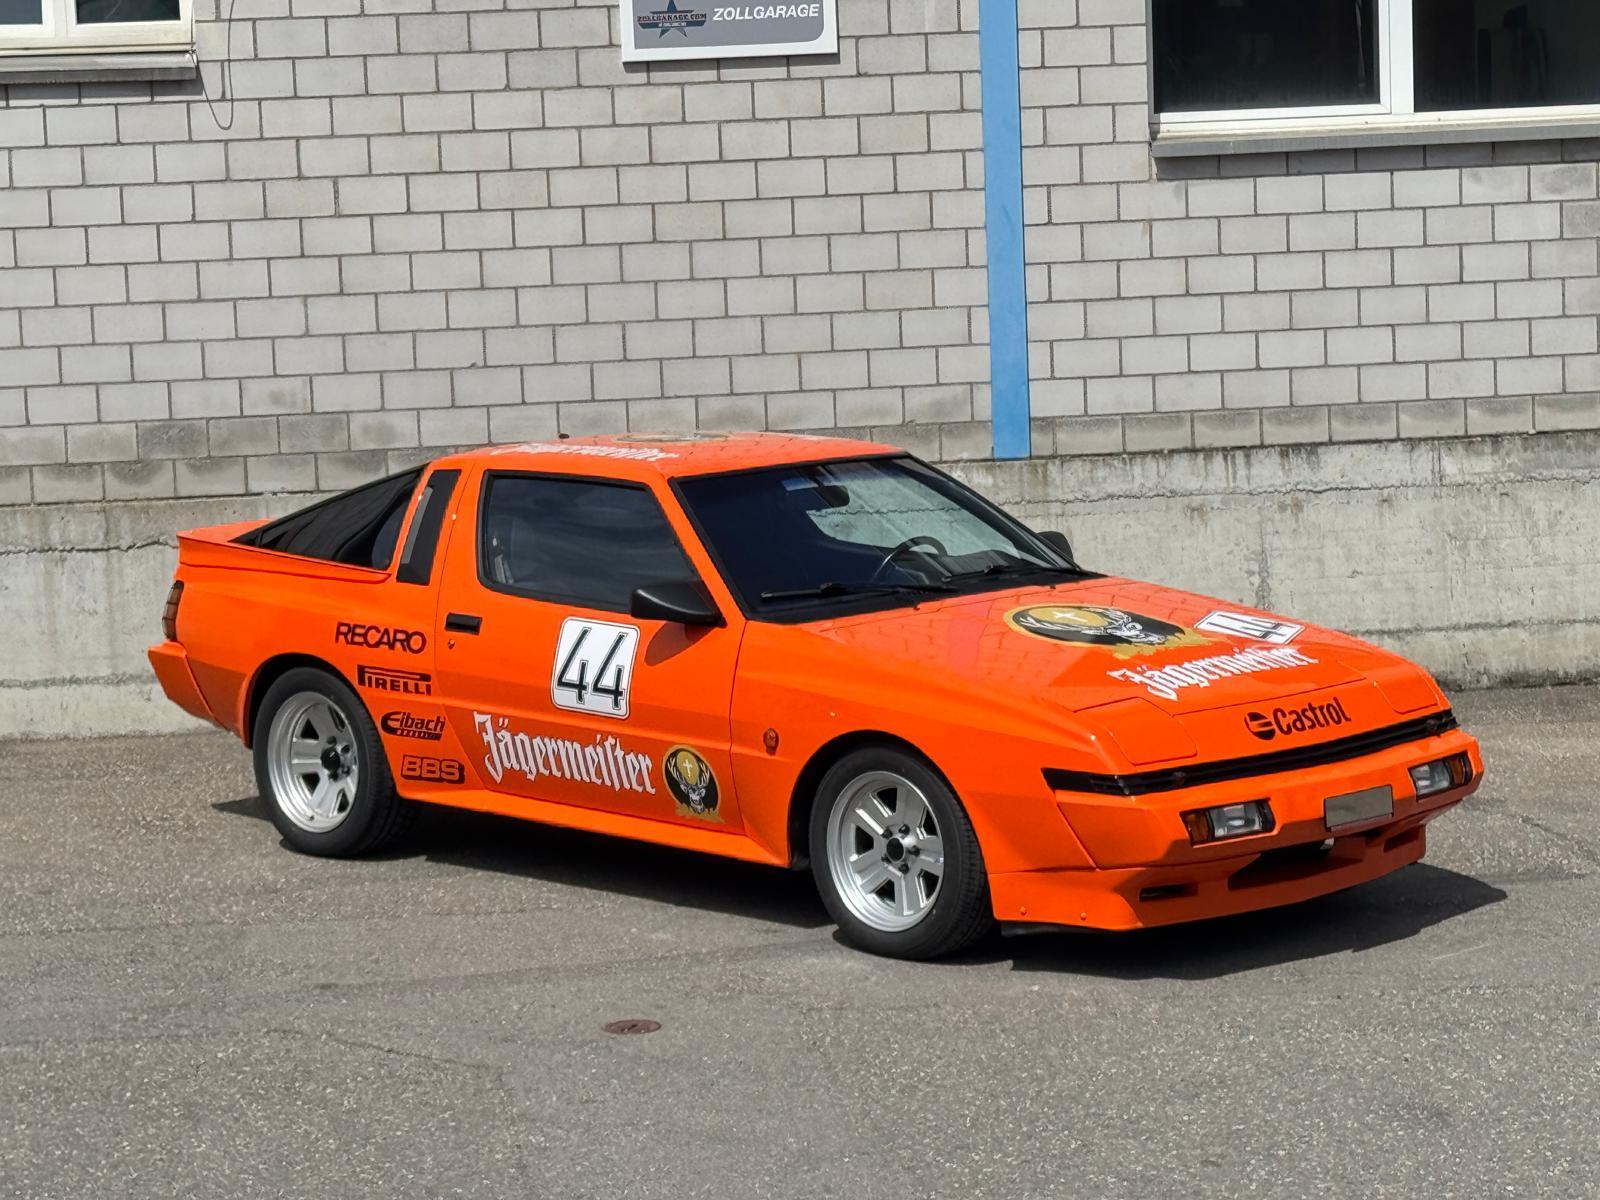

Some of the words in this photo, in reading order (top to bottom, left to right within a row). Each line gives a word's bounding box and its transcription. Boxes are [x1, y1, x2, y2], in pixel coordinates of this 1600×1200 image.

[713, 4, 819, 21] ZOLLGARAGE
[335, 621, 427, 654] RECARO
[357, 664, 432, 696] PIRELLI
[555, 627, 628, 710] 44
[381, 711, 446, 735] Eibach
[1272, 697, 1352, 736] Castrol
[401, 754, 465, 784] BBS
